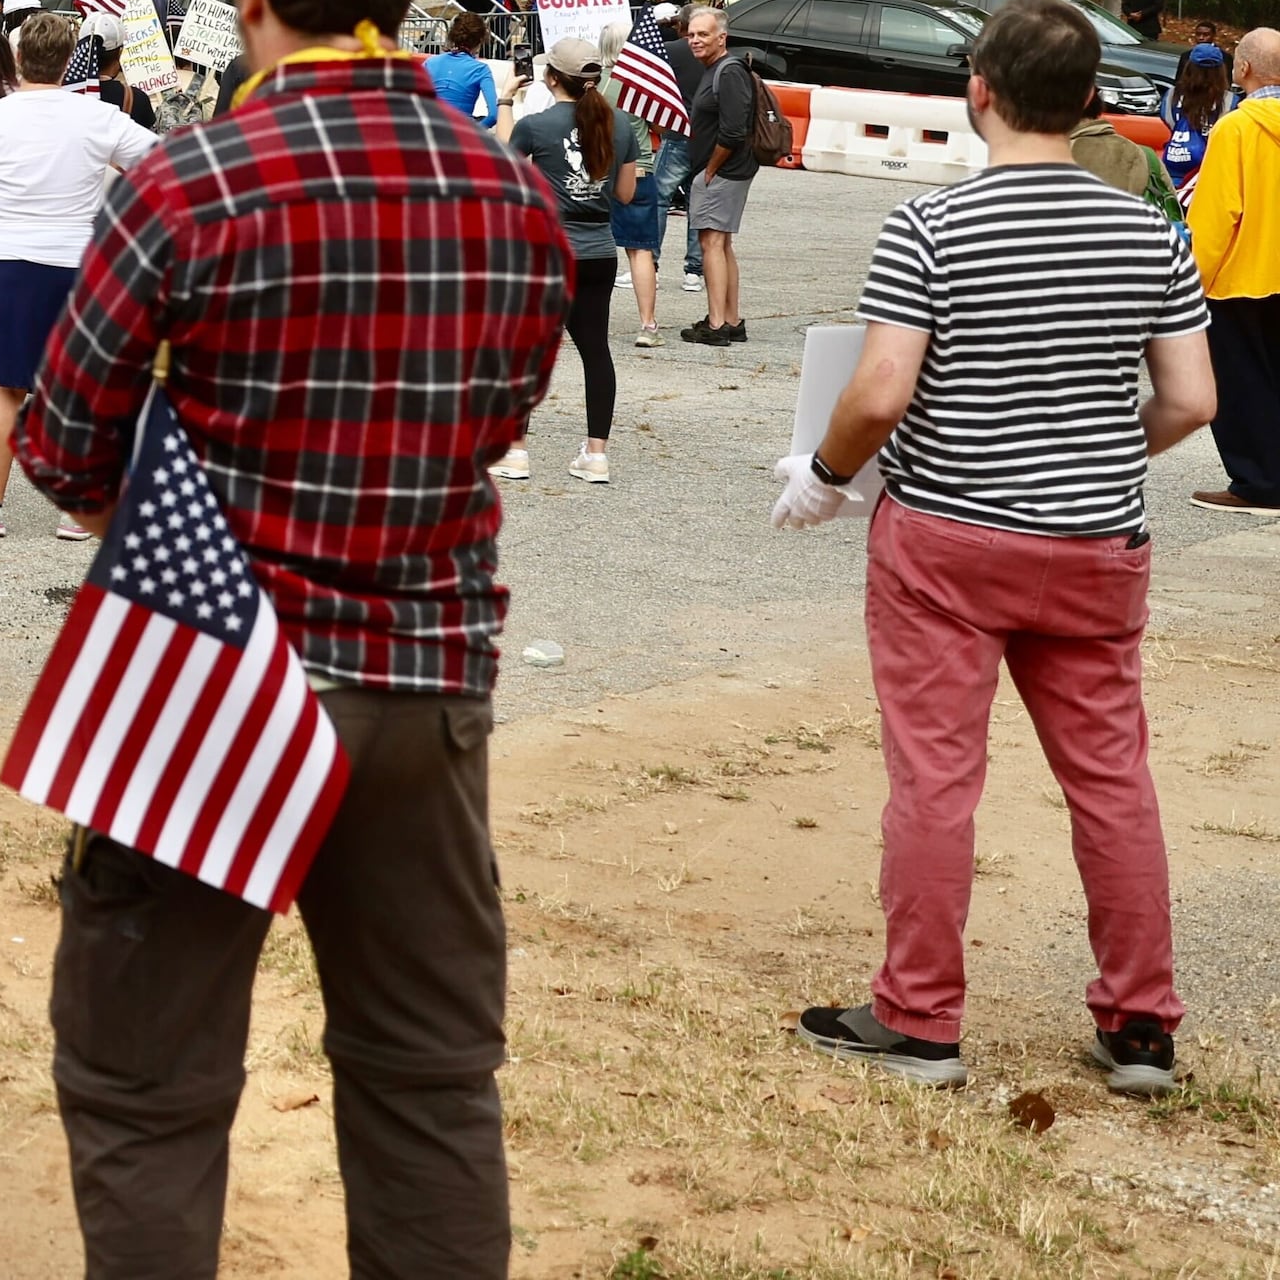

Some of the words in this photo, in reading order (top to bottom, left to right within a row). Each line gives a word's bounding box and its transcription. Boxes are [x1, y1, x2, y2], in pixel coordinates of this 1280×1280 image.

[191, 0, 207, 13] NO
[180, 37, 208, 53] BUILT
[145, 63, 161, 75] THE
